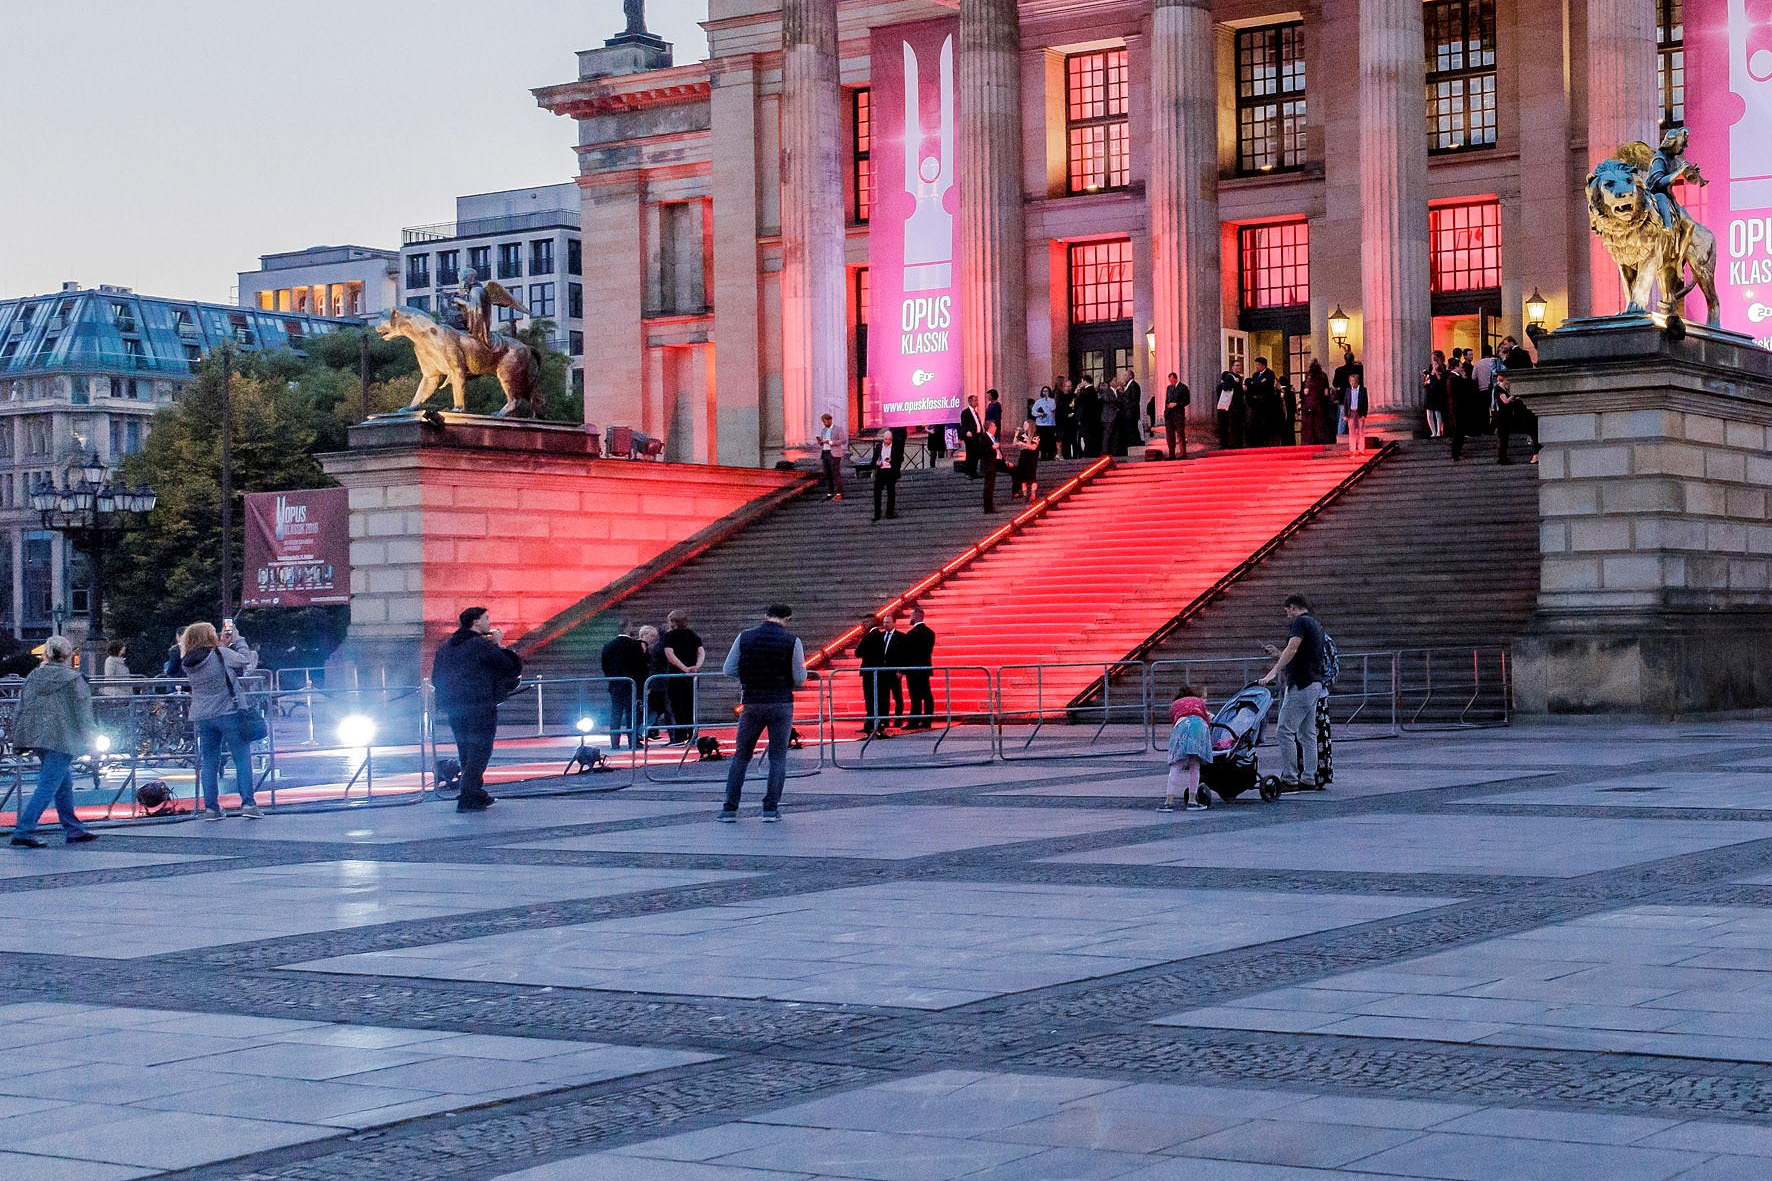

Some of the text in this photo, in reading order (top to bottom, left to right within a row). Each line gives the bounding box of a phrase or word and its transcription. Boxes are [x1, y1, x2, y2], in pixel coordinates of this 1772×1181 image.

[901, 295, 951, 332] OPUS
[901, 331, 949, 355] KLASSIK
[883, 396, 960, 415] www.opusklassik.de
[284, 505, 307, 524] OPUS
